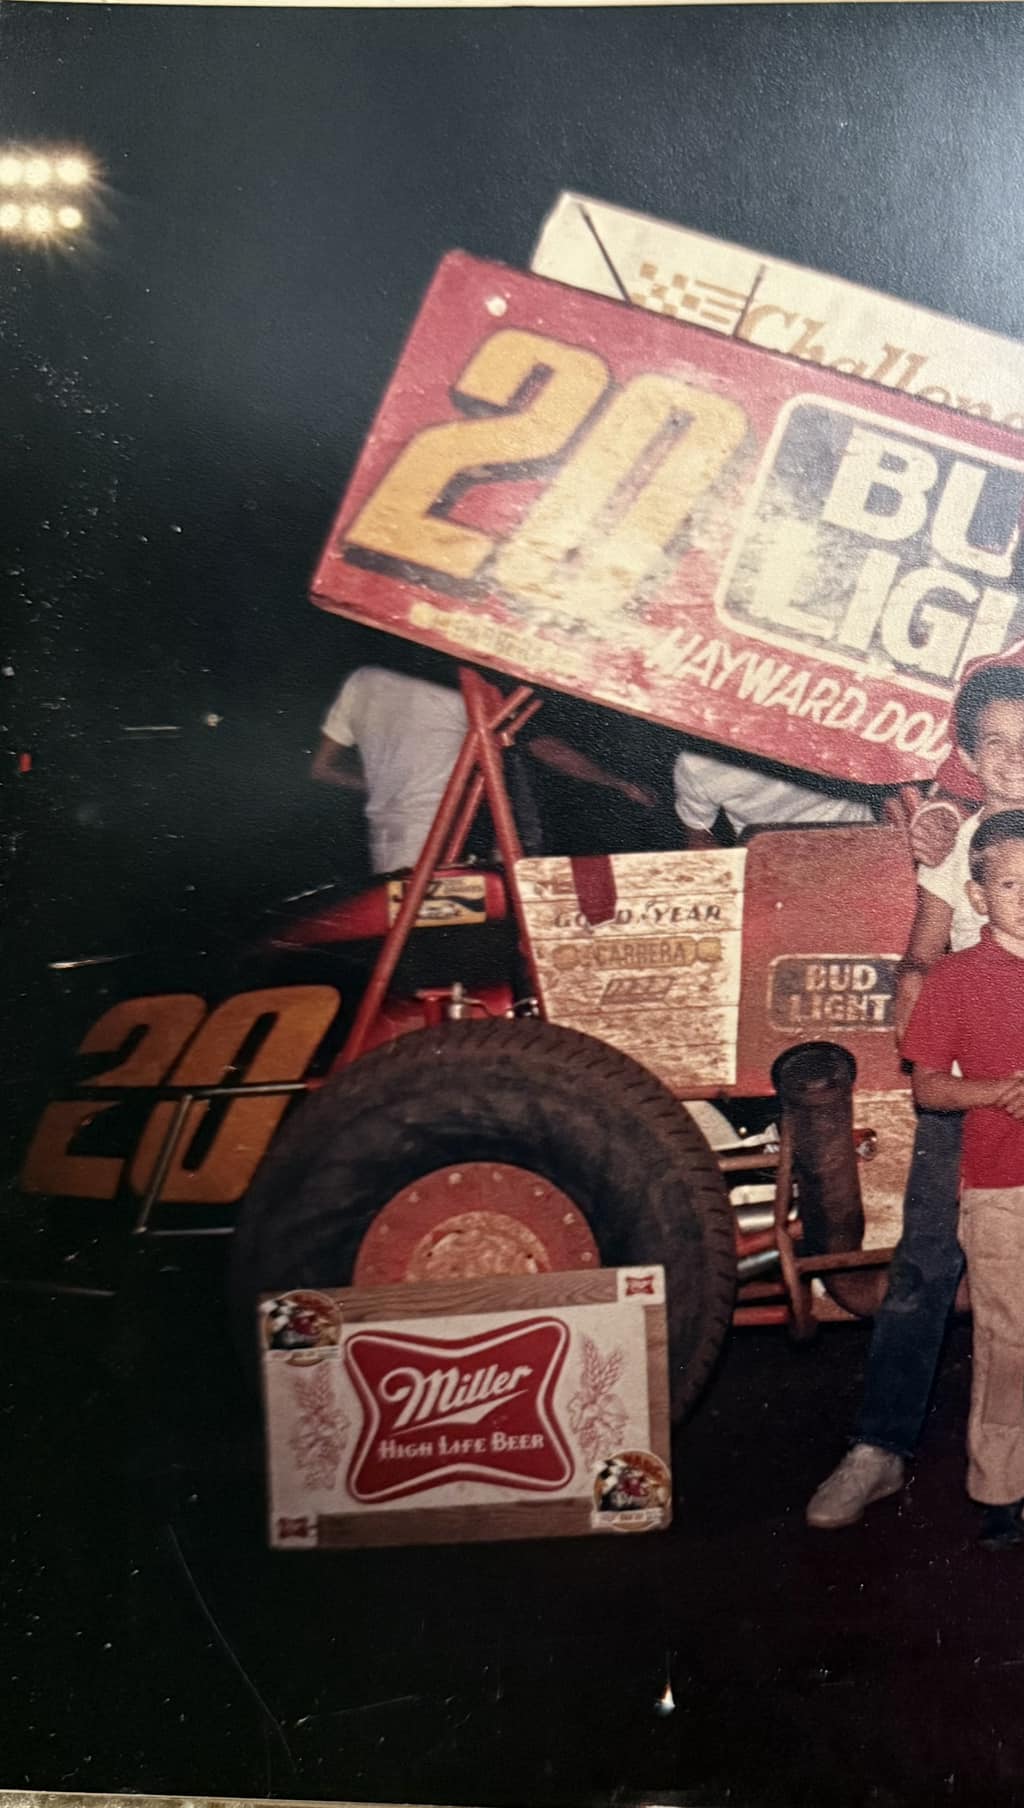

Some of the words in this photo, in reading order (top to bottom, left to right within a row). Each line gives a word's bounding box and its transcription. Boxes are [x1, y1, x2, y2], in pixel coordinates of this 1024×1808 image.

[344, 328, 748, 605] 20
[822, 427, 1014, 578] BU
[751, 520, 1018, 680] LIG
[645, 627, 867, 729] HAYWARD
[595, 941, 687, 964] CARRERA
[805, 964, 877, 991] BUD
[789, 994, 893, 1020] LIGHT
[22, 985, 340, 1202] 20
[379, 1363, 534, 1429] Miller
[379, 1439, 433, 1460] HIGH
[438, 1434, 487, 1455] LIFE
[491, 1431, 545, 1452] BEER
